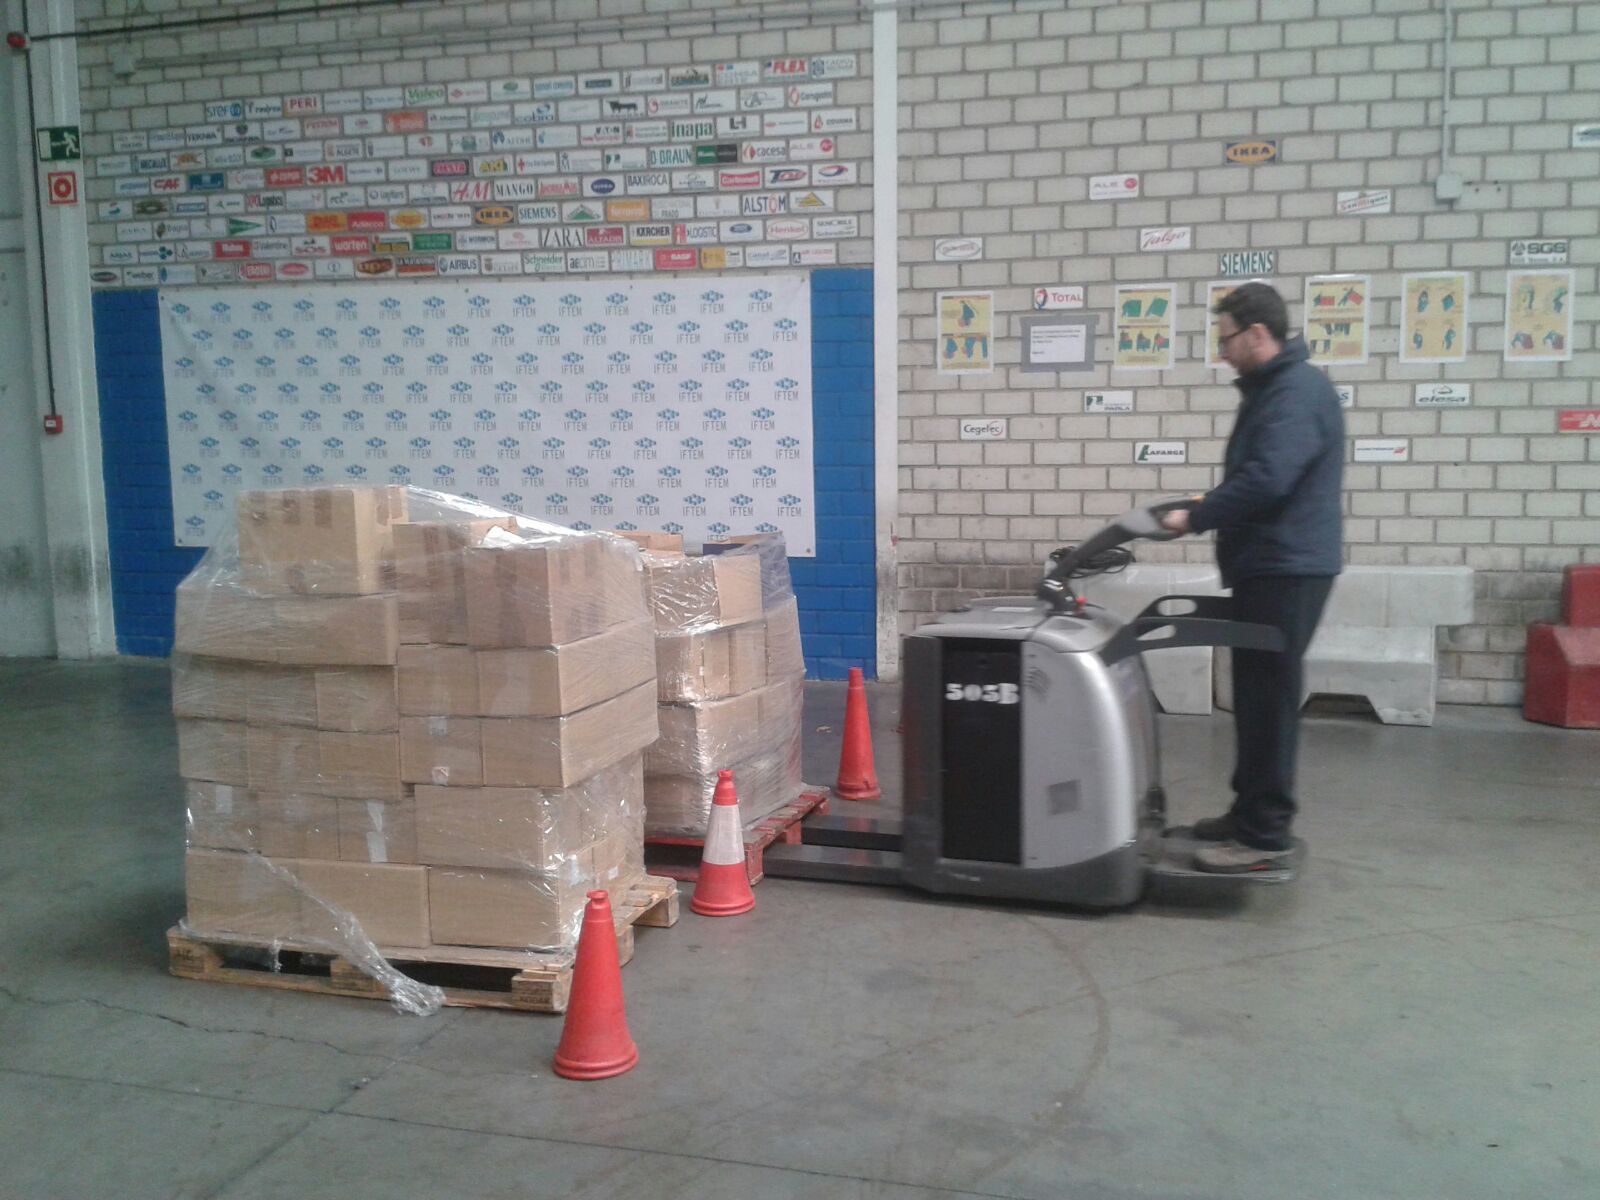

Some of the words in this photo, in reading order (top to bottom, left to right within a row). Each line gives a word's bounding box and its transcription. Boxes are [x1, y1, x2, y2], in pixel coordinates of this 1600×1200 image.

[773, 59, 807, 73] FLEX
[408, 87, 443, 100] Valeo
[290, 97, 317, 110] PERI
[515, 111, 554, 123] cobra
[659, 148, 692, 165] BRAUN
[757, 145, 785, 158] cacesa
[1232, 146, 1271, 157] IKEA
[308, 165, 344, 185] 3M
[627, 174, 668, 187] BAXIROCA
[153, 178, 181, 191] CAF
[496, 183, 534, 197] MANGO
[743, 194, 787, 213] ALSTOM
[480, 209, 511, 219] IKEA
[519, 206, 557, 221] SIEMENS
[351, 221, 384, 229] Adecco
[770, 223, 805, 235] Henkel
[542, 227, 583, 248] ZARA
[1142, 229, 1186, 249] Talgo
[334, 239, 367, 251] worten
[1527, 242, 1567, 255] SGS
[450, 258, 478, 270] AIRBUS
[524, 253, 563, 271] Schneider
[1221, 252, 1273, 273] SIEMENS
[1052, 292, 1084, 303] TOTAL
[513, 306, 537, 317] IFTEM
[559, 305, 583, 316] IFTEM
[605, 304, 630, 315] IFTEM
[652, 303, 677, 314] IFTEM
[699, 302, 725, 313] IFTEM
[748, 301, 773, 312] IFTEM
[423, 307, 446, 319] IFTEM
[468, 307, 491, 318] IFTEM
[447, 336, 470, 347] IFTEM
[491, 335, 515, 346] IFTEM
[537, 334, 561, 345] IFTEM
[583, 333, 607, 345] IFTEM
[629, 333, 654, 344] IFTEM
[676, 332, 701, 344] IFTEM
[724, 332, 749, 343] IFTEM
[771, 331, 797, 343] IFTEM
[425, 365, 449, 375] IFTEM
[470, 364, 494, 375] IFTEM
[516, 364, 539, 375] IFTEM
[561, 363, 586, 374] IFTEM
[608, 363, 632, 374] IFTEM
[655, 362, 679, 374] IFTEM
[702, 362, 727, 373] IFTEM
[749, 361, 774, 373] IFTEM
[450, 393, 473, 403] IFTEM
[495, 392, 518, 403] IFTEM
[540, 392, 564, 403] IFTEM
[586, 391, 610, 403] IFTEM
[632, 391, 656, 402] IFTEM
[678, 391, 703, 402] IFTEM
[724, 390, 750, 401] IFTEM
[773, 390, 798, 401] IFTEM
[429, 421, 452, 432] IFTEM
[473, 421, 497, 431] IFTEM
[519, 421, 542, 431] IFTEM
[564, 420, 588, 431] IFTEM
[610, 420, 635, 431] IFTEM
[657, 420, 682, 431] IFTEM
[704, 419, 728, 431] IFTEM
[751, 419, 776, 430] IFTEM
[963, 422, 1001, 436] Cegelec
[452, 448, 476, 459] IFTEM
[497, 448, 521, 459] IFTEM
[542, 448, 566, 459] IFTEM
[588, 448, 612, 459] IFTEM
[634, 448, 658, 459] IFTEM
[680, 448, 705, 459] IFTEM
[727, 448, 752, 459] IFTEM
[775, 447, 800, 458] IFTEM
[431, 477, 454, 487] IFTEM
[476, 477, 499, 487] IFTEM
[520, 477, 544, 488] IFTEM
[566, 477, 590, 488] IFTEM
[612, 477, 636, 488] IFTEM
[658, 477, 683, 488] IFTEM
[705, 477, 730, 488] IFTEM
[753, 477, 778, 488] IFTEM
[545, 504, 569, 515] IFTEM
[591, 504, 615, 515] IFTEM
[636, 505, 660, 516] IFTEM
[682, 505, 707, 516] IFTEM
[729, 506, 754, 516] IFTEM
[777, 506, 801, 516] IFTEM
